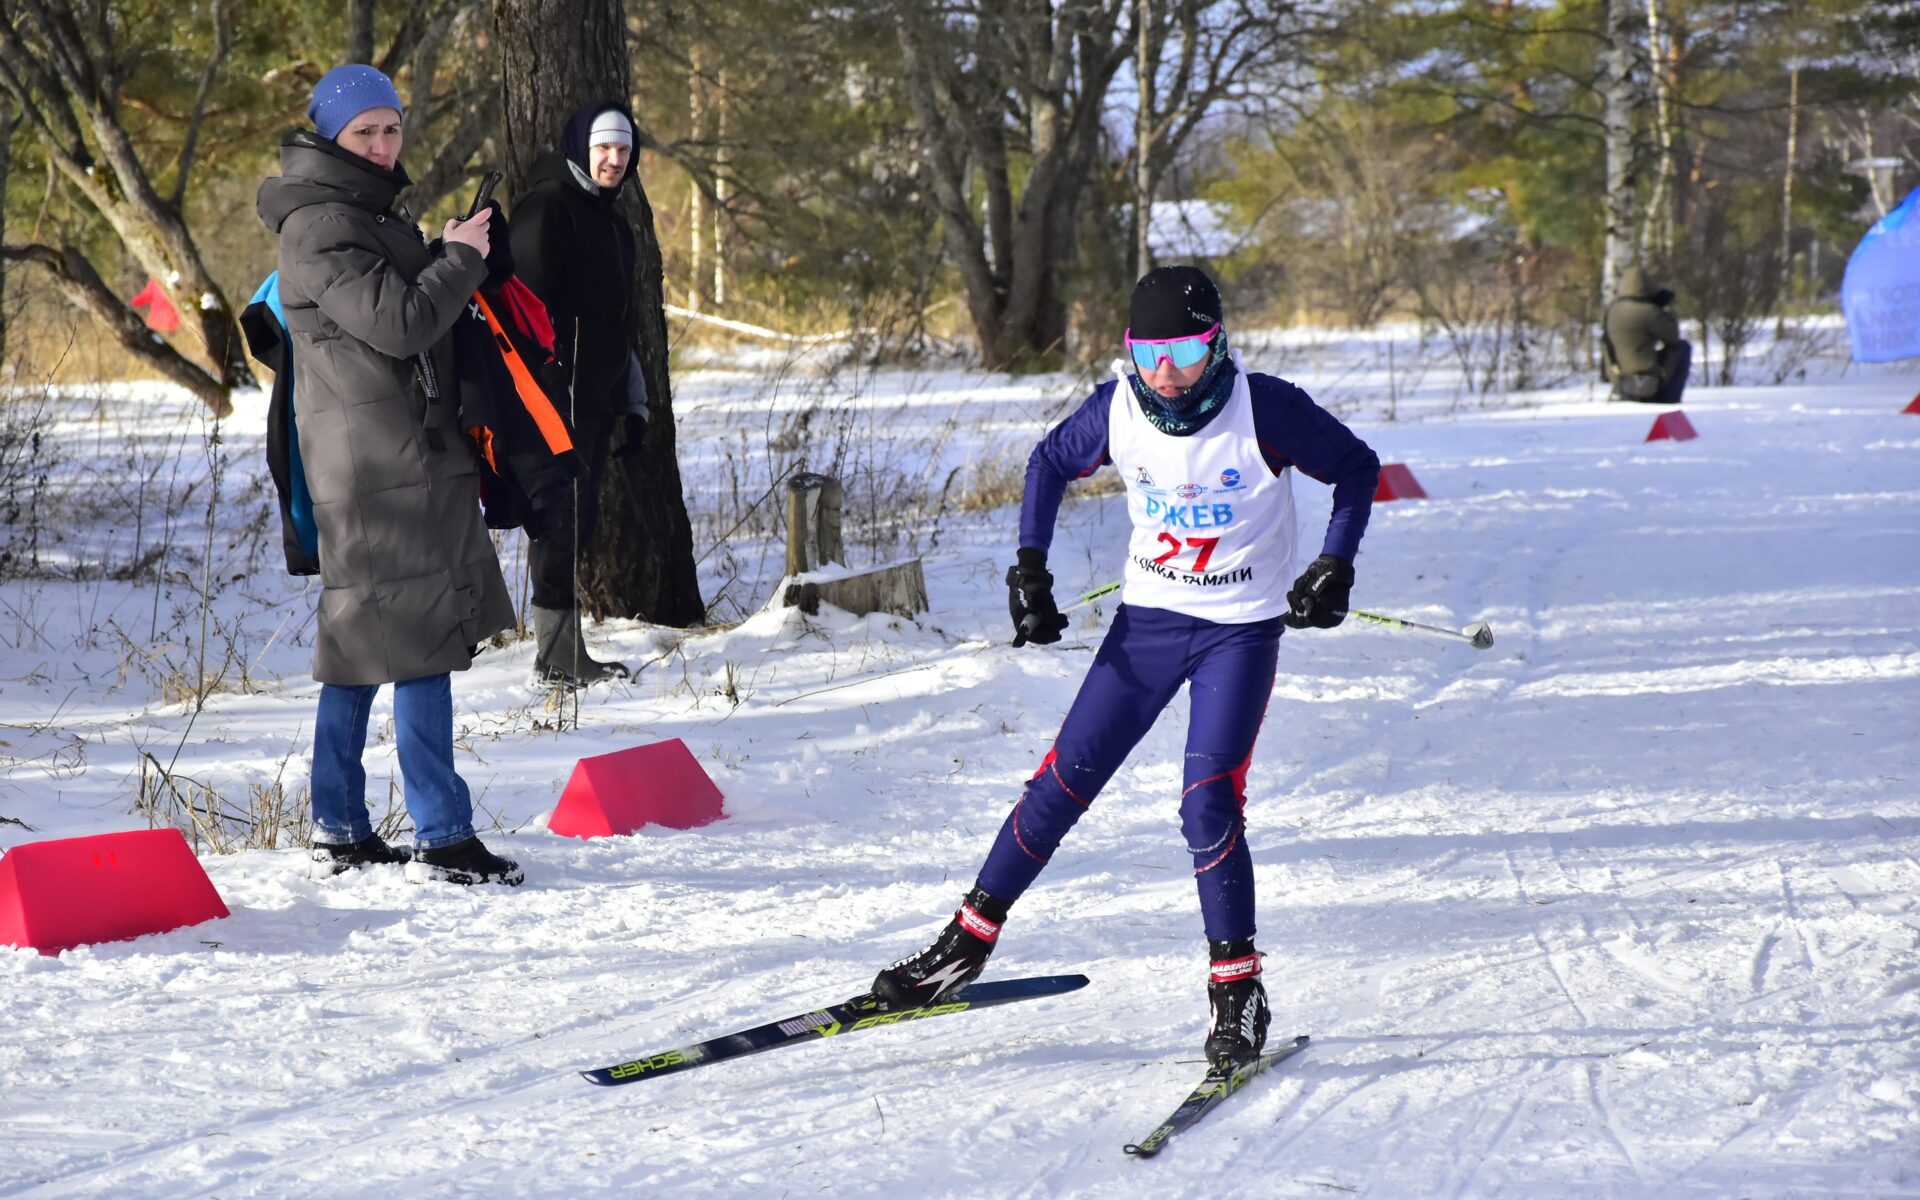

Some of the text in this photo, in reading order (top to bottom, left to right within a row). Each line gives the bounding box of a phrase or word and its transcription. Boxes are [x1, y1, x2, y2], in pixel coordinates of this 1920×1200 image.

[1146, 496, 1233, 528] РЖЕВ
[1153, 532, 1220, 573] 27
[1211, 959, 1255, 973] MADSHUS
[850, 1002, 970, 1033] FISCHER
